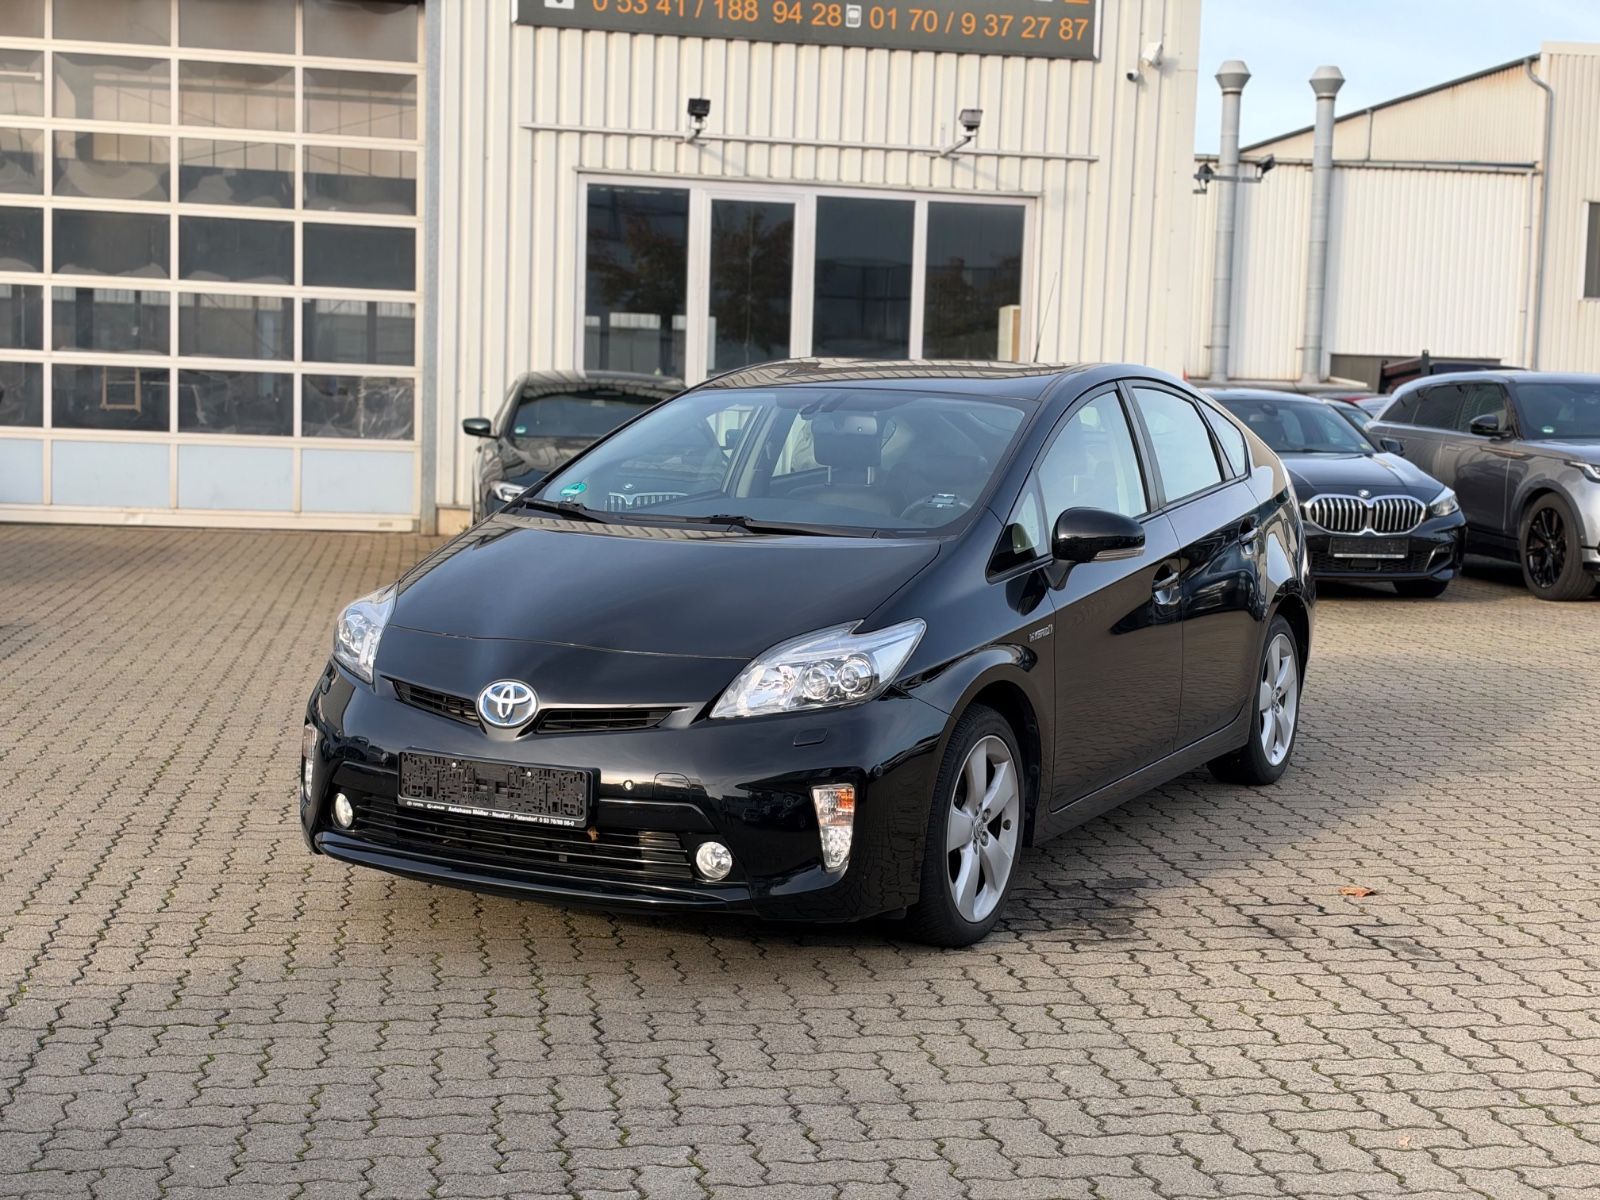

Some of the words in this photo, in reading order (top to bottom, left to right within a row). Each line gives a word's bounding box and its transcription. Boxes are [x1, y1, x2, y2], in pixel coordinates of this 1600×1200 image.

[656, 0, 684, 16] 41
[714, 0, 759, 21] 188
[773, 0, 803, 24] 94
[811, 3, 842, 27] 28
[869, 7, 897, 30] 01
[908, 9, 938, 33] 70
[944, 12, 954, 34] /
[960, 12, 976, 35] 9
[983, 14, 1014, 37] 37
[1021, 16, 1051, 39] 27
[1058, 18, 1089, 41] 87
